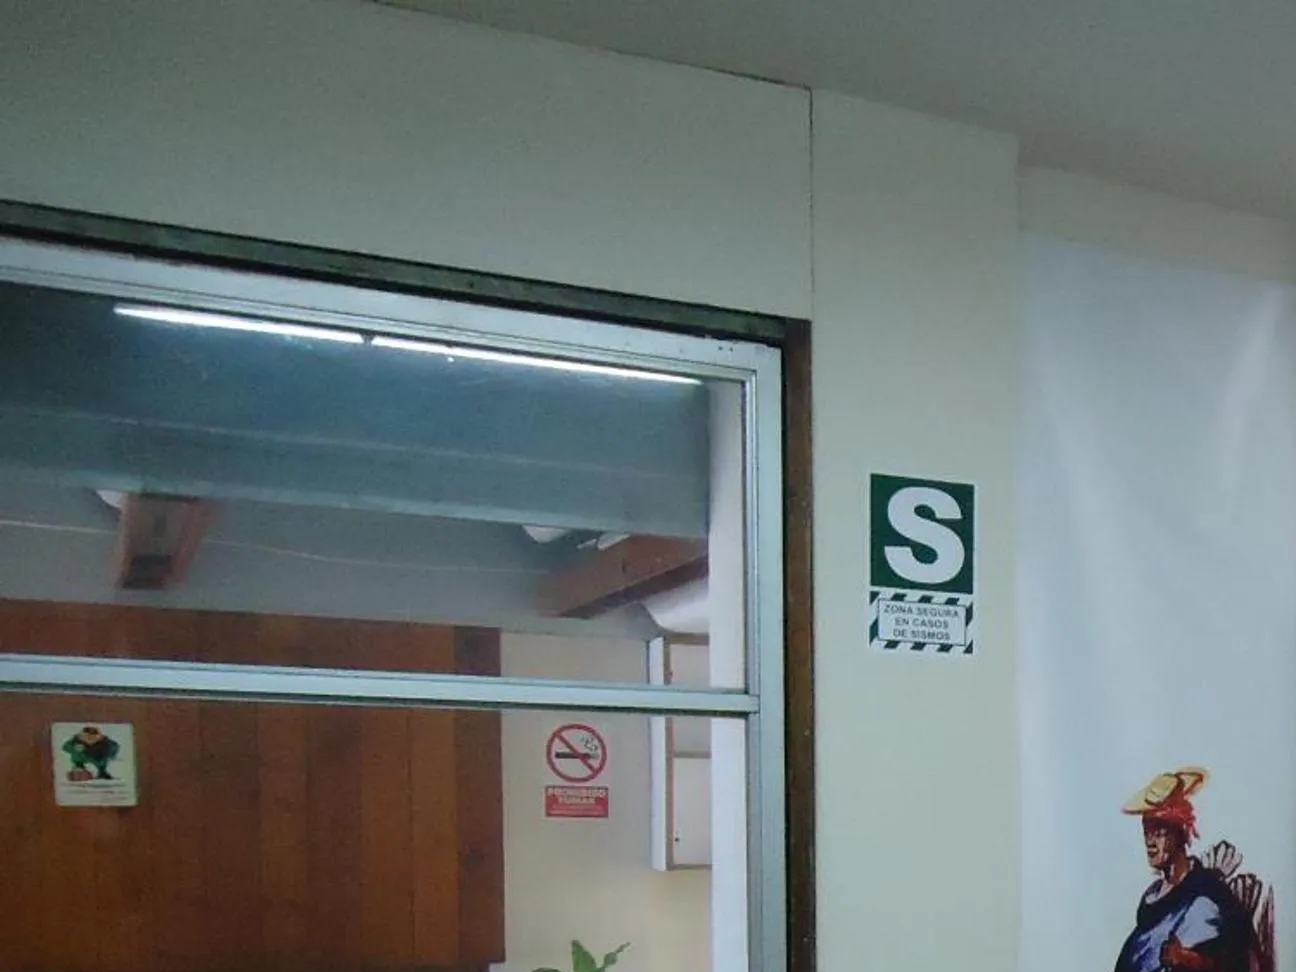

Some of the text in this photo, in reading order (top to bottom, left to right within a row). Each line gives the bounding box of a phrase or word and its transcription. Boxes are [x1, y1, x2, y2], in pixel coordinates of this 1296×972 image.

[884, 486, 965, 585] S
[884, 604, 959, 618] ZONA SEGURA
[895, 618, 949, 629] EN CASOS
[893, 628, 950, 641] DE SISMOS
